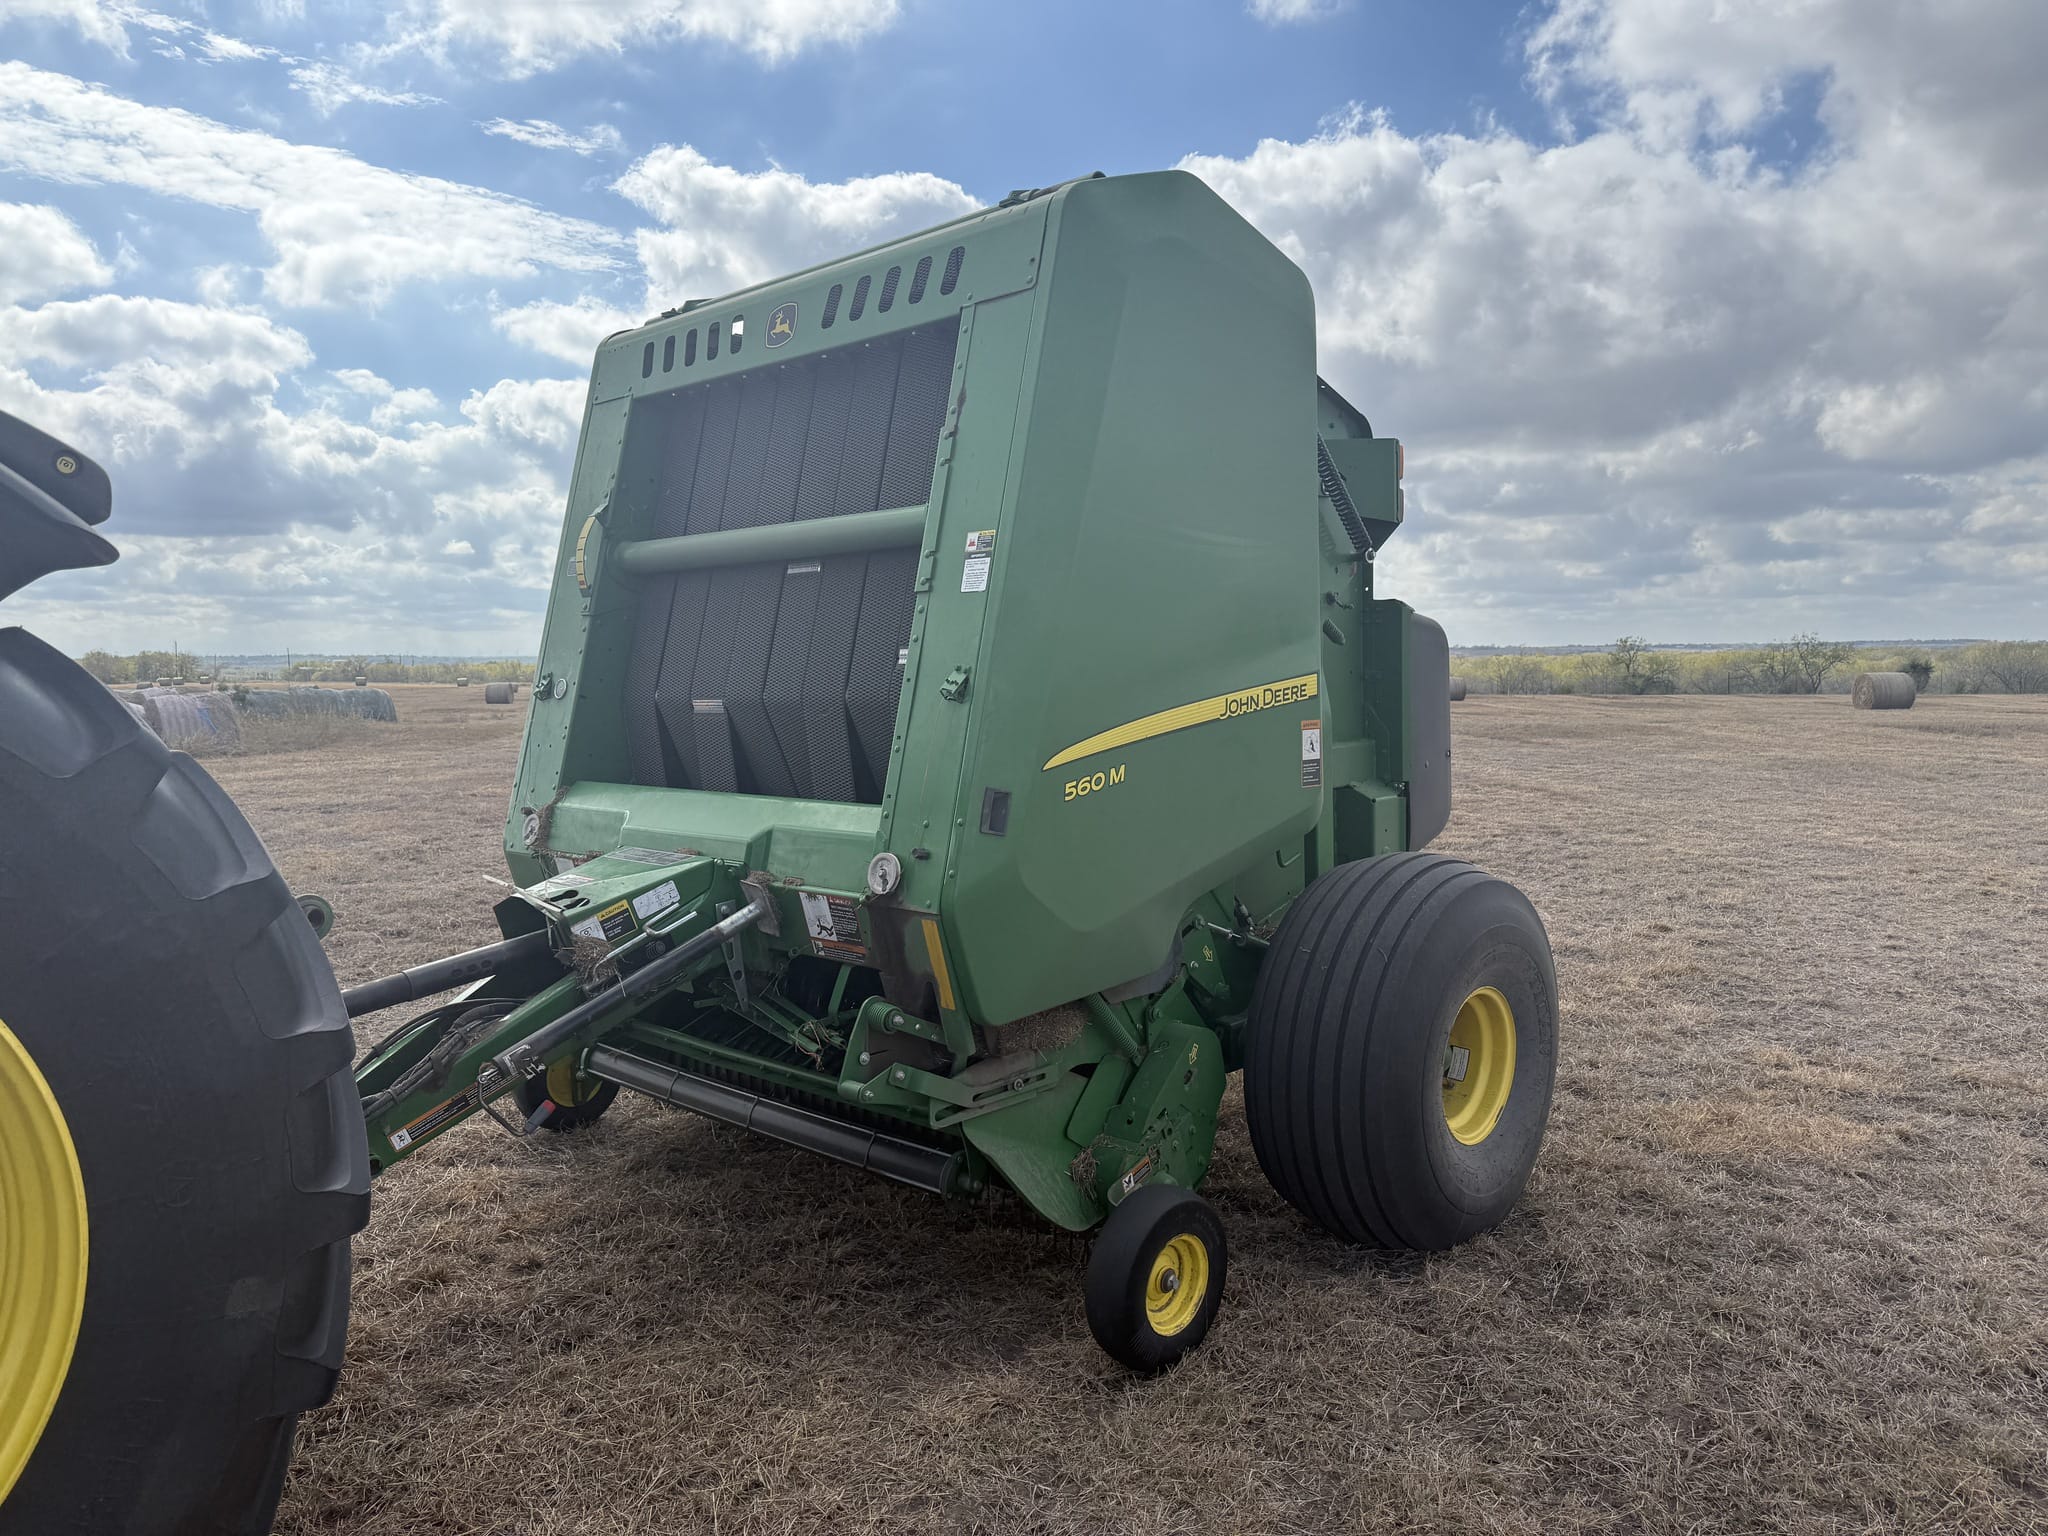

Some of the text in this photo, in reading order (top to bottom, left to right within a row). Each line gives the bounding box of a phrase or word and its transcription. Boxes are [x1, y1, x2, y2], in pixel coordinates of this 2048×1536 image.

[1220, 683, 1308, 717] JOHN DEERE
[1064, 763, 1126, 802] 560 M
